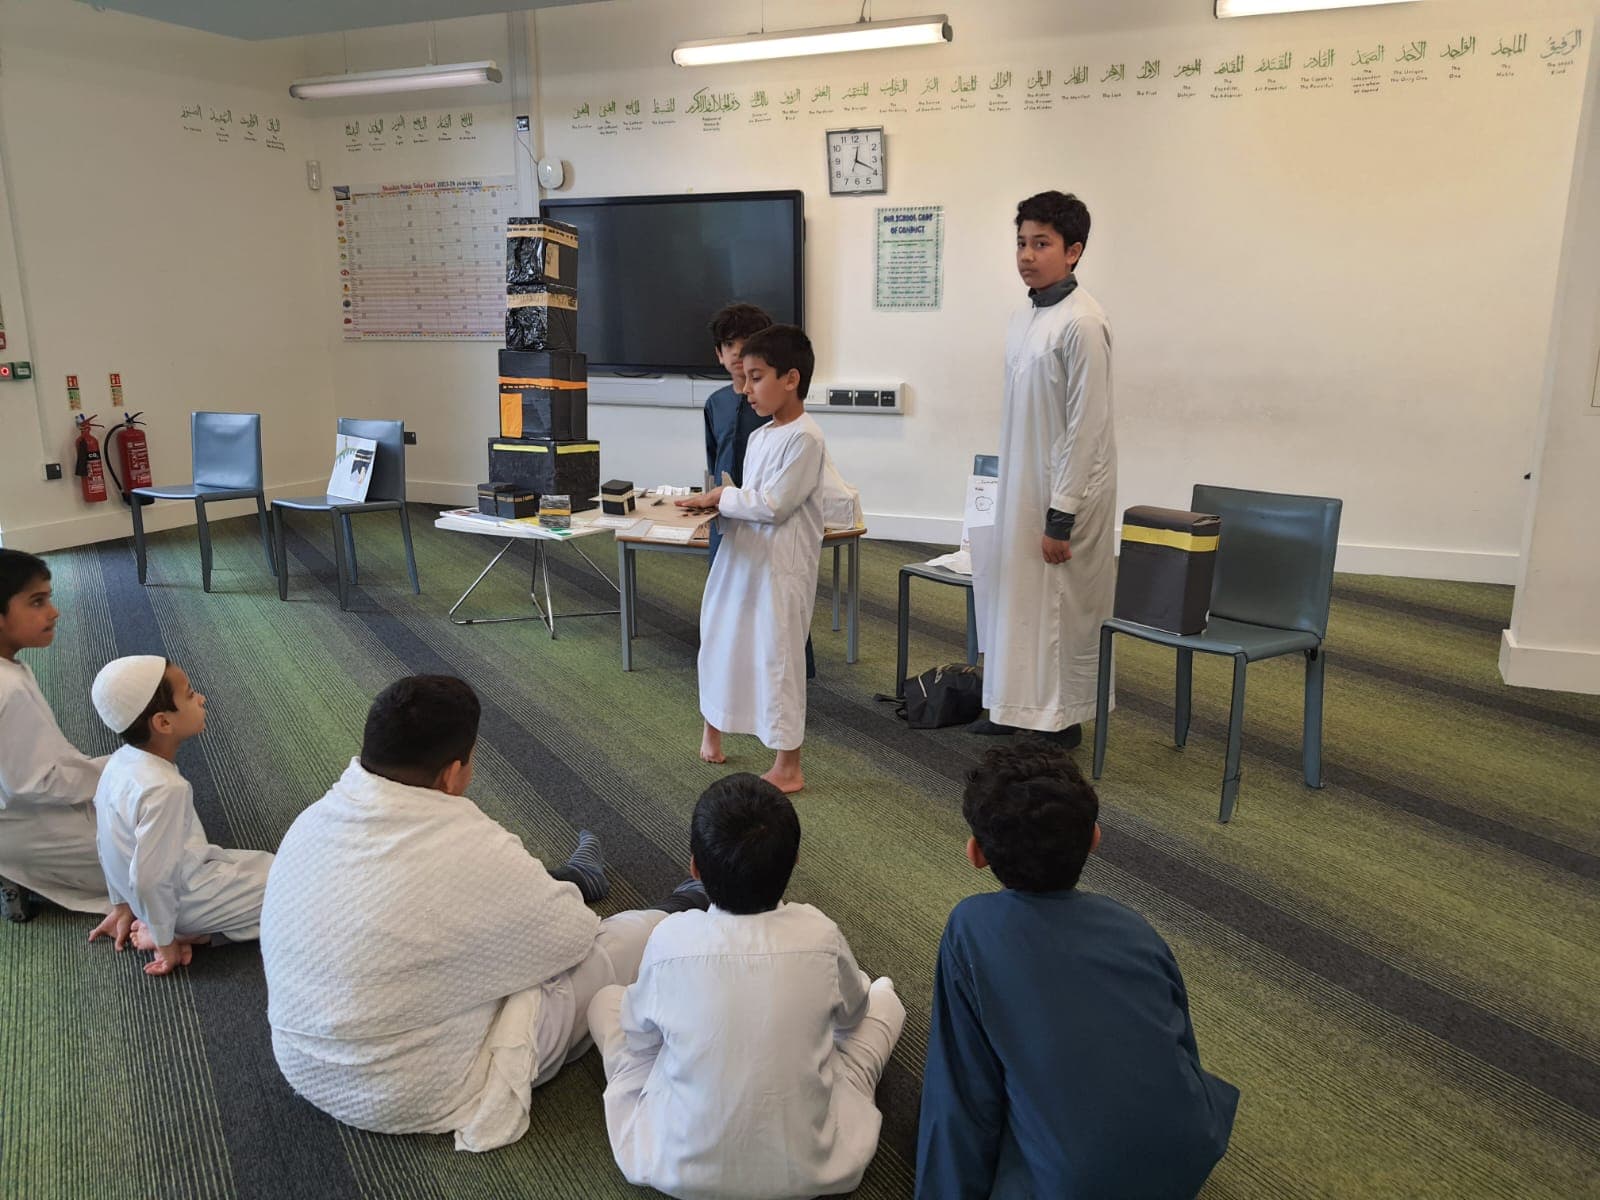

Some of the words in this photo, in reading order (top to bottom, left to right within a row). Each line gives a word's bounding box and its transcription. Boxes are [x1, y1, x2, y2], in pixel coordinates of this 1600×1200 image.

[895, 214, 917, 222] SCHOOL
[890, 226, 898, 234] OF
[898, 226, 925, 234] CONDUCT
